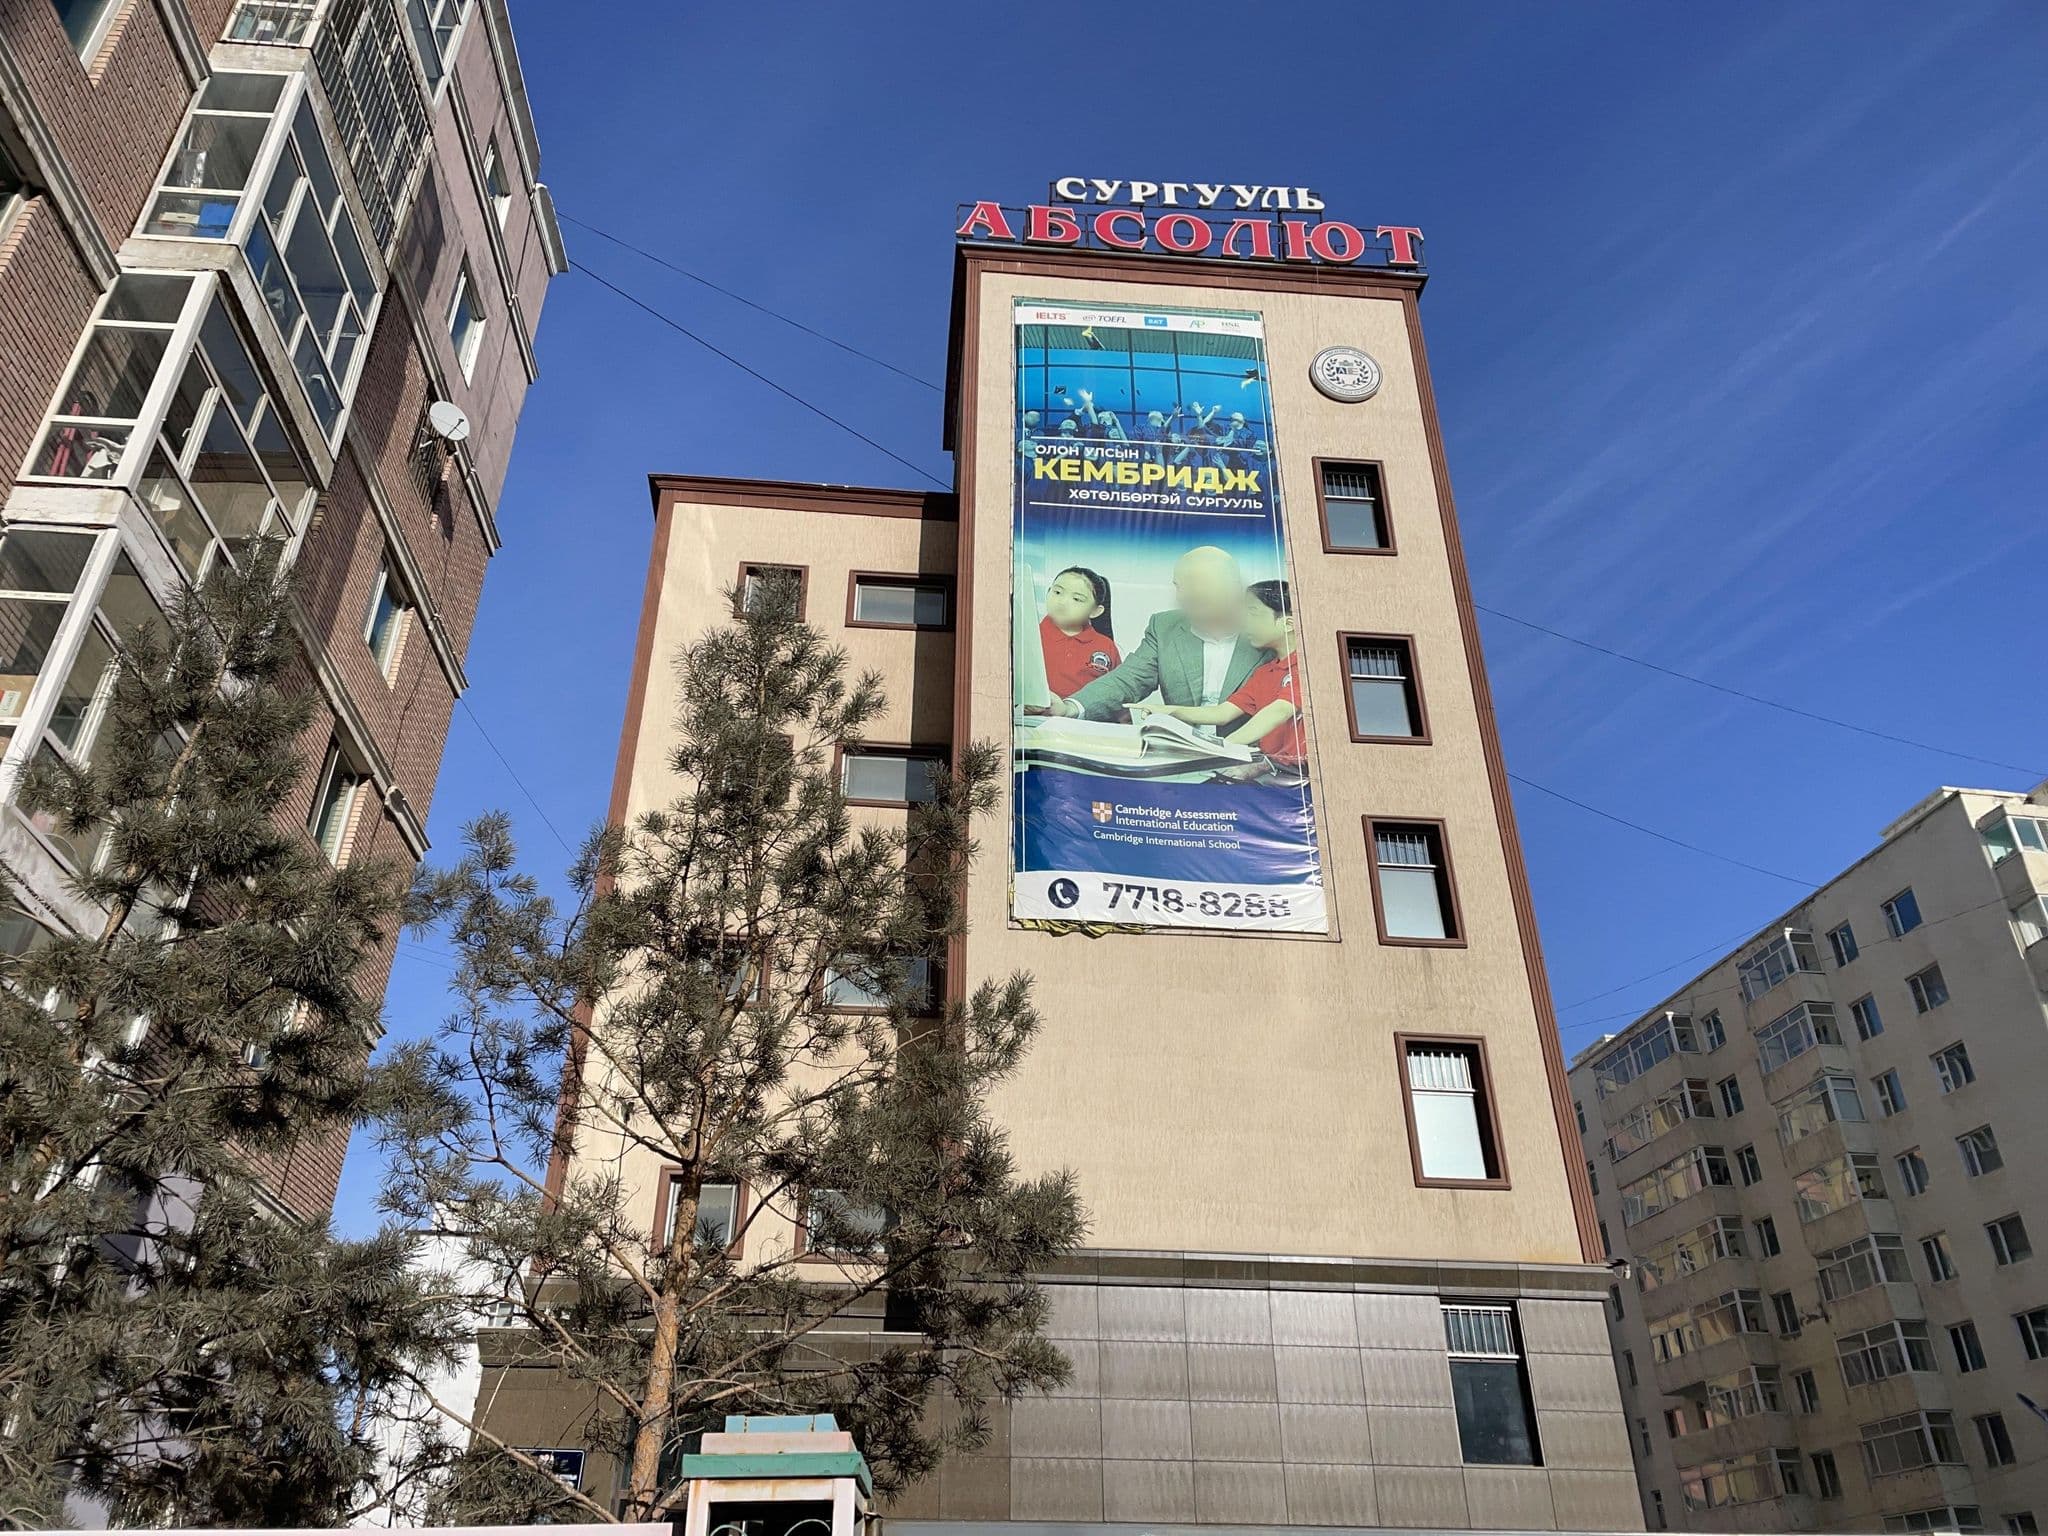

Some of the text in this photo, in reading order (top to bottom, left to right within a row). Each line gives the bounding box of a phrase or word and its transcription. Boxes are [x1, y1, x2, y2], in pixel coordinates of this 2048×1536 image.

[1055, 176, 1326, 210] СУРГУУЛЬ
[956, 200, 1425, 266] АБСОЛЮТ
[1036, 311, 1067, 320] IELTS
[1098, 315, 1127, 323] TOEFL
[1034, 444, 1139, 459] ОЛОН УЛСЫН
[1034, 458, 1262, 494] КЕМБРИДЖ
[1068, 488, 1264, 509] ХӨТӨЛБӨРТЭЙ СУРГУУЛЬ
[1115, 804, 1238, 820] Cambridge Assessment
[1115, 815, 1234, 831] International Education
[1093, 830, 1241, 849] Cambridge International School
[1102, 882, 1292, 918] 7718-8288
